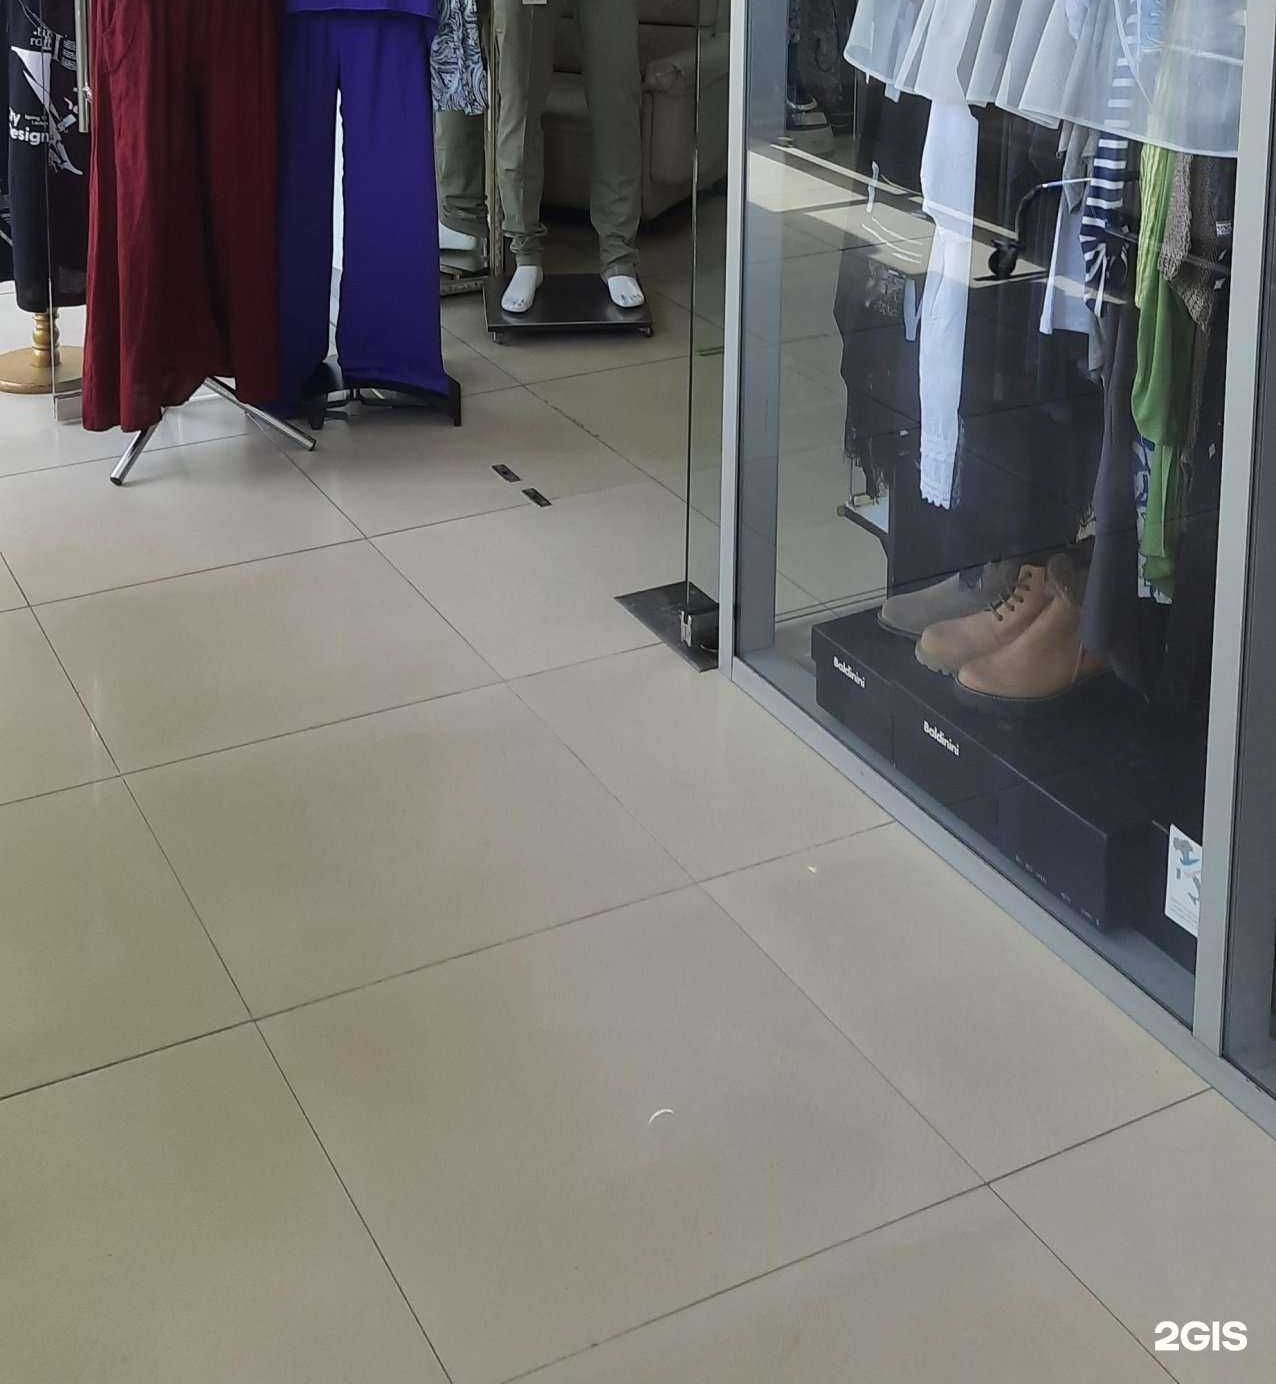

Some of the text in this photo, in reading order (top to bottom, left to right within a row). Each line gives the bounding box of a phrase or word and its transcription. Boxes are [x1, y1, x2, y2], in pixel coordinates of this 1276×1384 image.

[9, 124, 49, 146] esign
[833, 655, 866, 689] Baldinini
[923, 719, 960, 757] Baldinini
